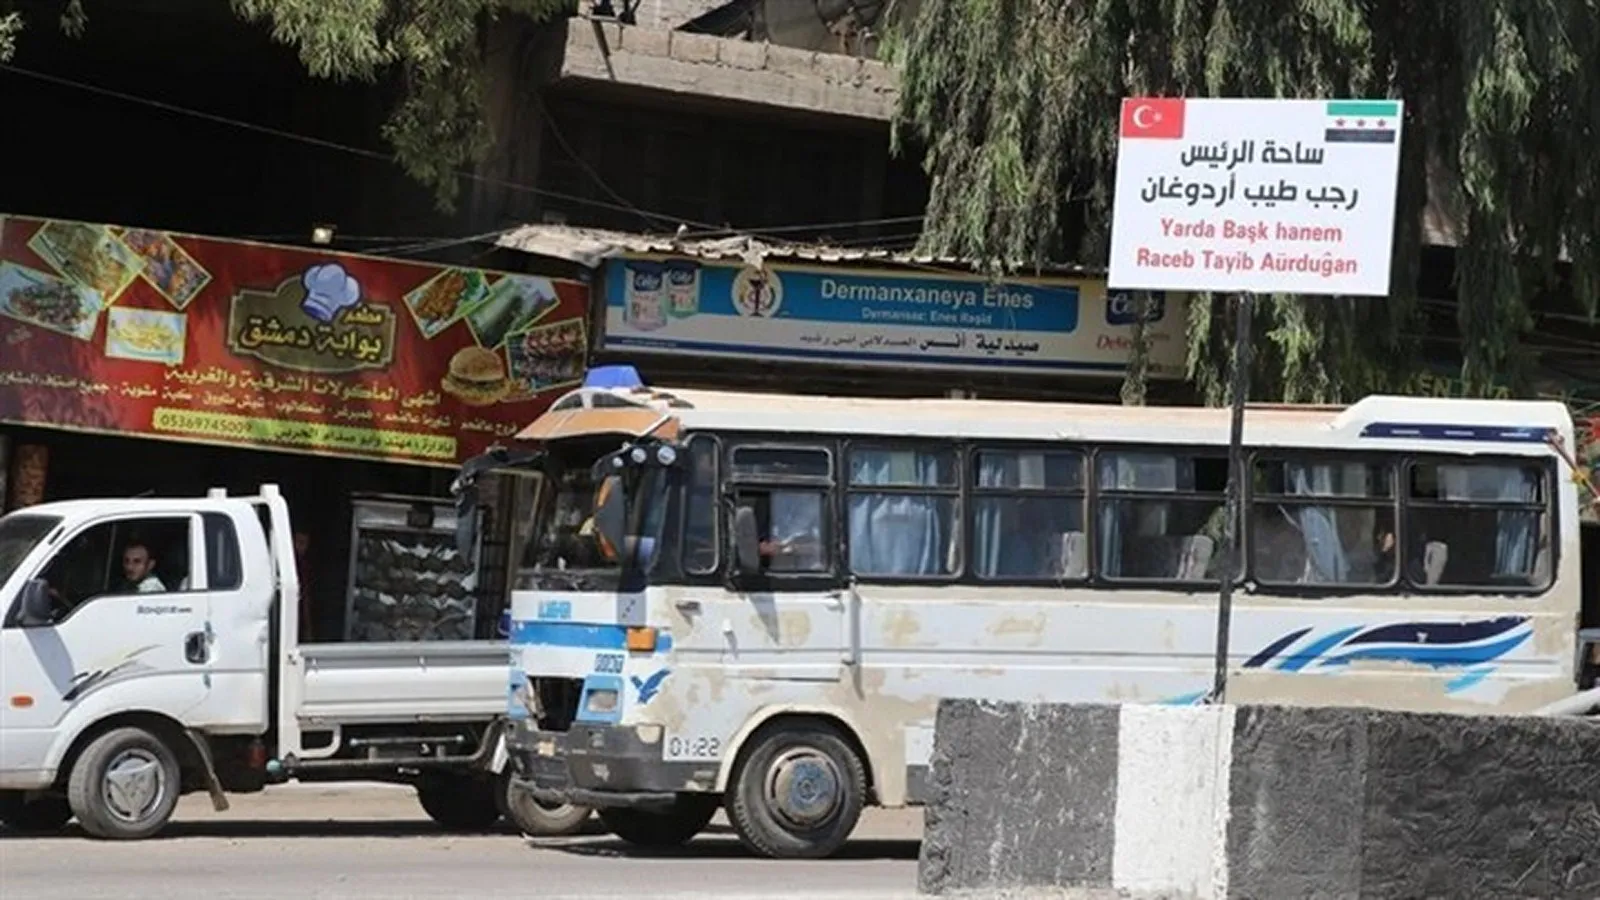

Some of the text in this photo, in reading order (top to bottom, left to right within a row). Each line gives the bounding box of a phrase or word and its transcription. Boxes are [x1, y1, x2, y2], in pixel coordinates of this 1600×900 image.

[1181, 140, 1324, 169] ساحة الرئيس
[1141, 173, 1359, 211] رجب طيب أردوغان
[1160, 218, 1342, 243] Yarda Başk hanem
[1137, 247, 1195, 270] Raceb
[1202, 249, 1253, 274] Tayib
[820, 278, 1035, 309] Dermanxaneya Enes
[240, 318, 382, 360] بوابة دمشق
[976, 333, 1039, 355] صيدلية
[239, 371, 308, 393] الشرقية
